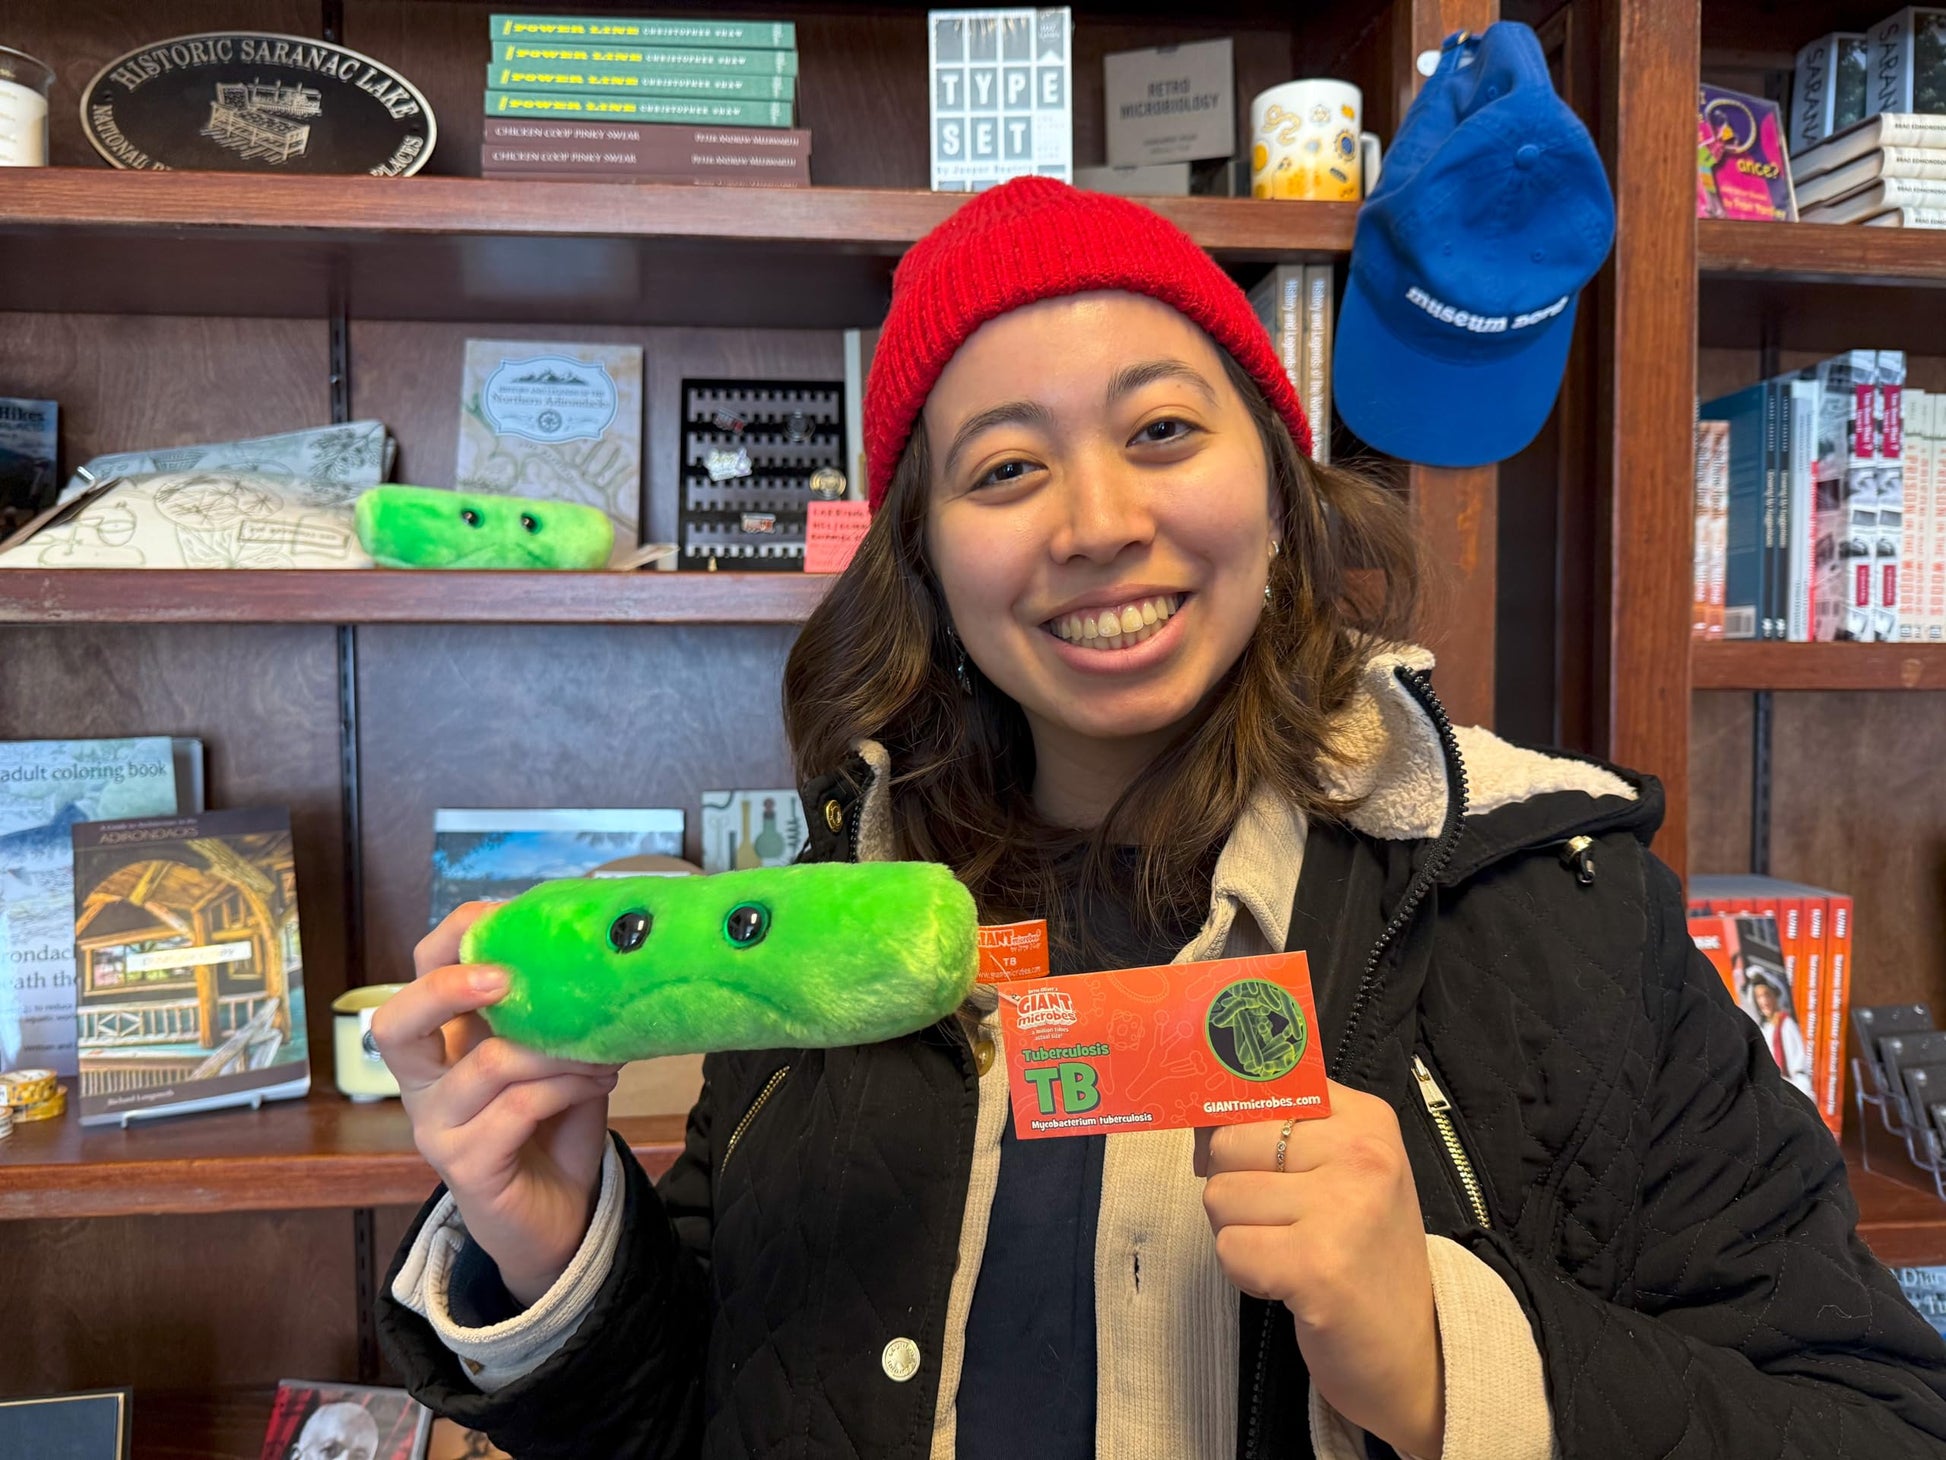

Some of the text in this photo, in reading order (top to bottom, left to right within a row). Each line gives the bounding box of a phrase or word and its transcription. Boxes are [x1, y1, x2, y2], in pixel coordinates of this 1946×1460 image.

[514, 23, 585, 34] POWER
[590, 25, 639, 35] LINE
[516, 49, 587, 60] POWER
[592, 51, 642, 62] LINE
[111, 39, 420, 120] HISTORIC SARANAC LAKE
[511, 73, 583, 84] POWER
[588, 75, 638, 86] LINE
[941, 72, 1059, 106] TYPE
[1147, 77, 1190, 97] RETRO
[508, 99, 581, 110] POWER
[586, 101, 636, 112] LINE
[1120, 93, 1219, 119] MICROBIOLOGY
[92, 104, 149, 169] NATIONAL
[942, 123, 1028, 155] SET
[1405, 286, 1507, 333] museum
[491, 391, 542, 407] Northern
[0, 760, 167, 784] adult coloring book
[1002, 956, 1017, 968] TB
[1018, 992, 1073, 1015] GIANT
[1018, 1010, 1077, 1027] microbes
[1022, 1043, 1110, 1062] Tuberculosis
[1024, 1062, 1100, 1114] TB
[1203, 1095, 1321, 1113] GIANTmicrobes.com
[1031, 1113, 1153, 1131] Mycobacterium tuberculosis
